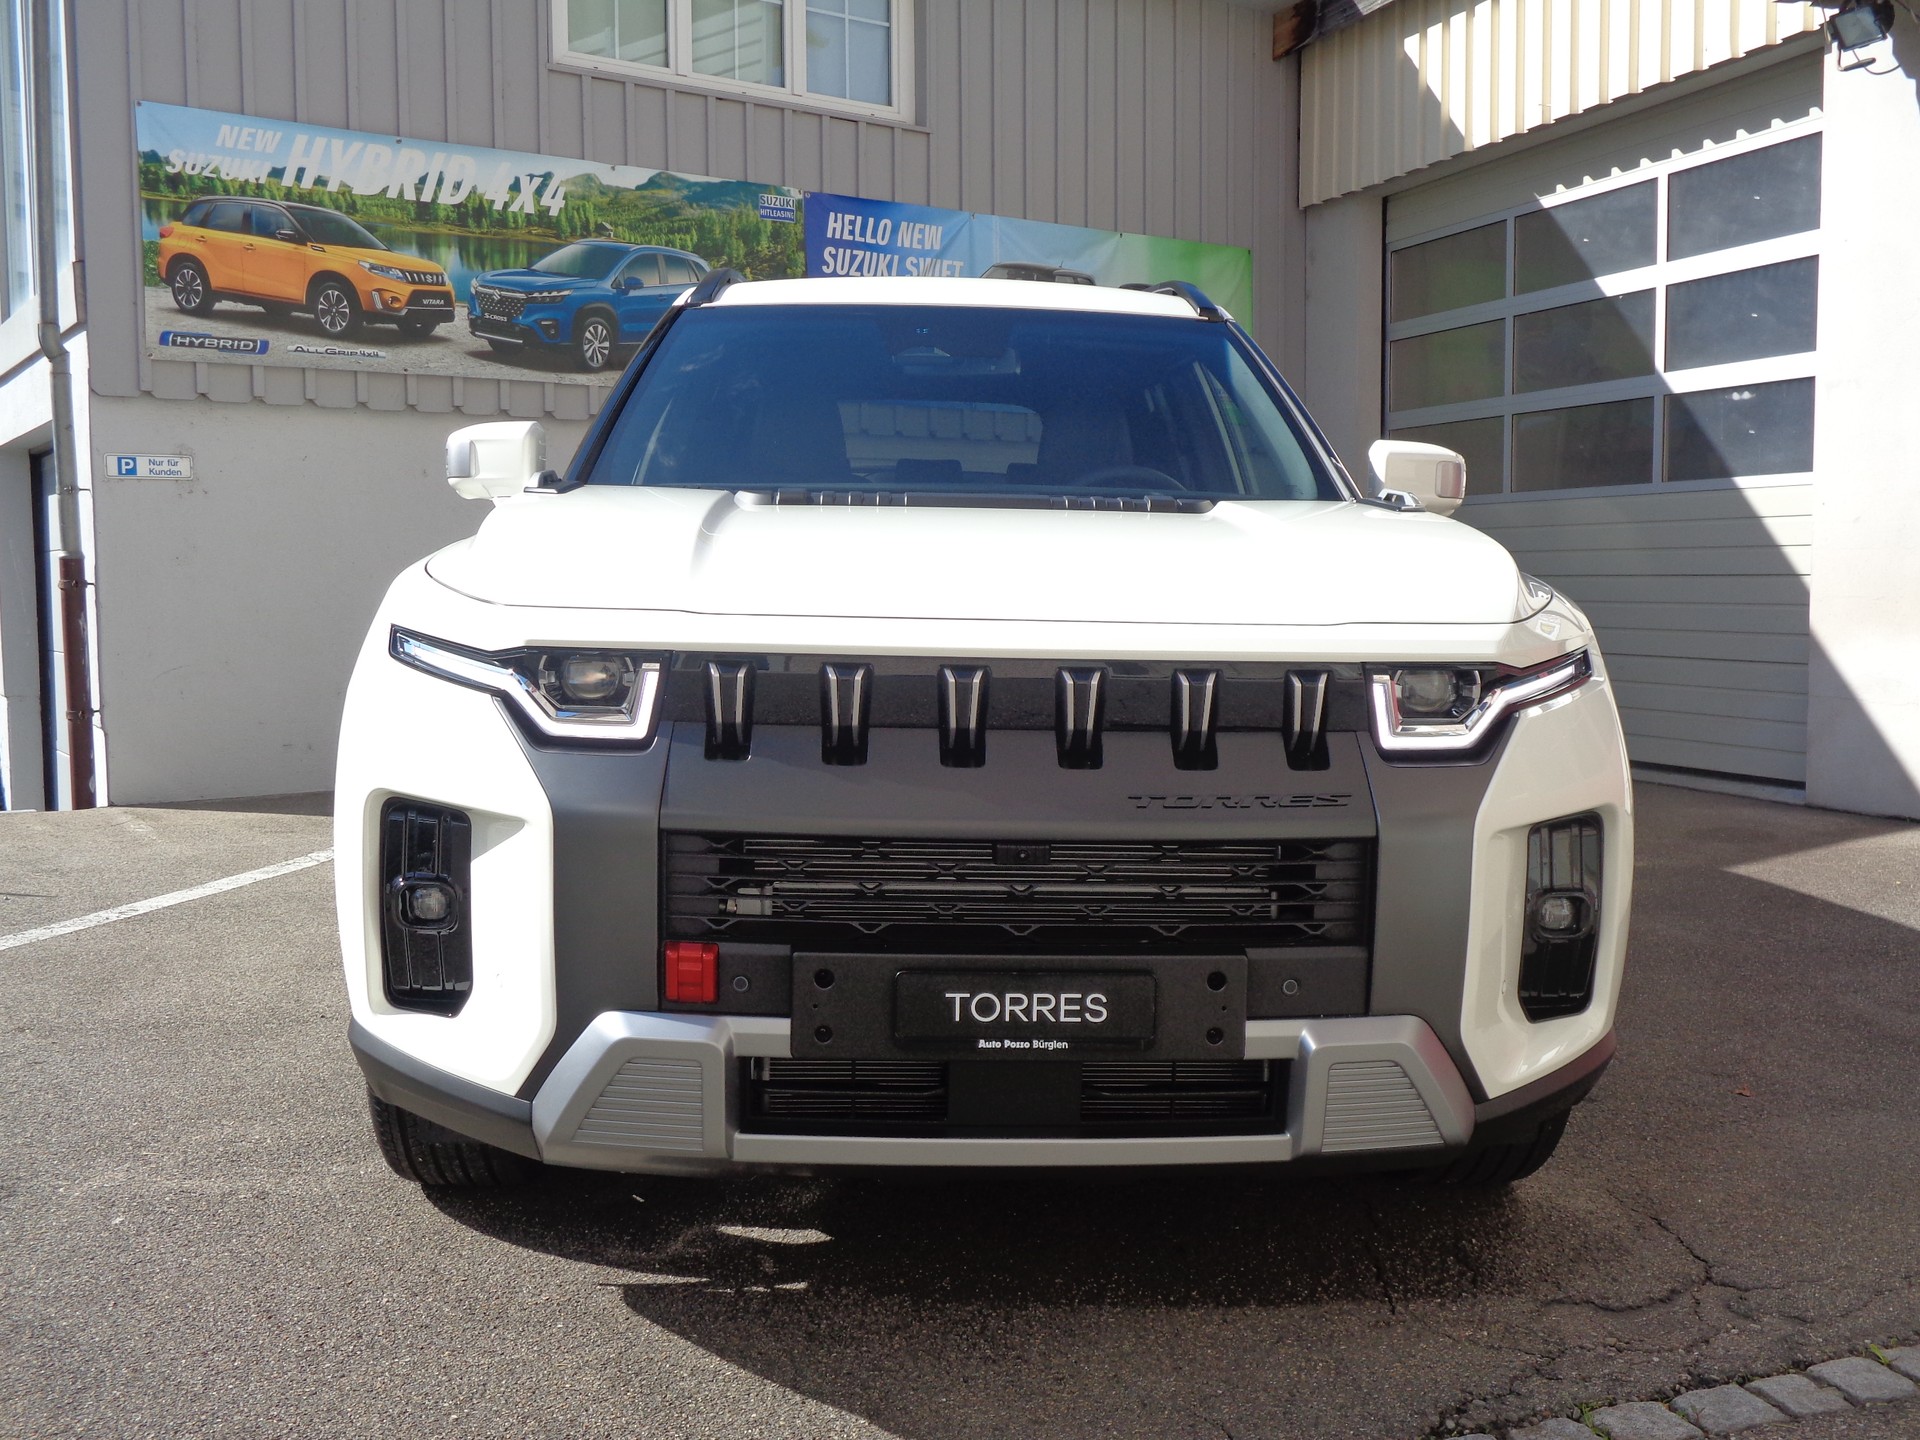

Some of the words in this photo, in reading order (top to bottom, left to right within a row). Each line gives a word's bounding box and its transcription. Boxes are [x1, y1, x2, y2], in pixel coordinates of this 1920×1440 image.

[216, 124, 283, 153] NEW
[165, 149, 273, 185] SUZUKI
[281, 134, 476, 205] HYBRID
[484, 162, 566, 216] 4x4
[760, 195, 795, 208] SUZUKI
[760, 208, 794, 219] HITLEASING
[826, 211, 892, 246] HELLO
[897, 221, 943, 250] NEW
[821, 246, 900, 277] SUZUKI
[176, 336, 254, 350] HYBRID
[121, 458, 134, 474] P
[148, 458, 164, 467] Nur
[167, 458, 179, 467] für
[149, 468, 182, 476] Kunden
[1127, 794, 1352, 809] TORRES
[945, 992, 1108, 1022] TORRES
[978, 1039, 1002, 1049] Auto
[1004, 1039, 1030, 1049] Pozzo
[1032, 1039, 1069, 1051] Bürglen
